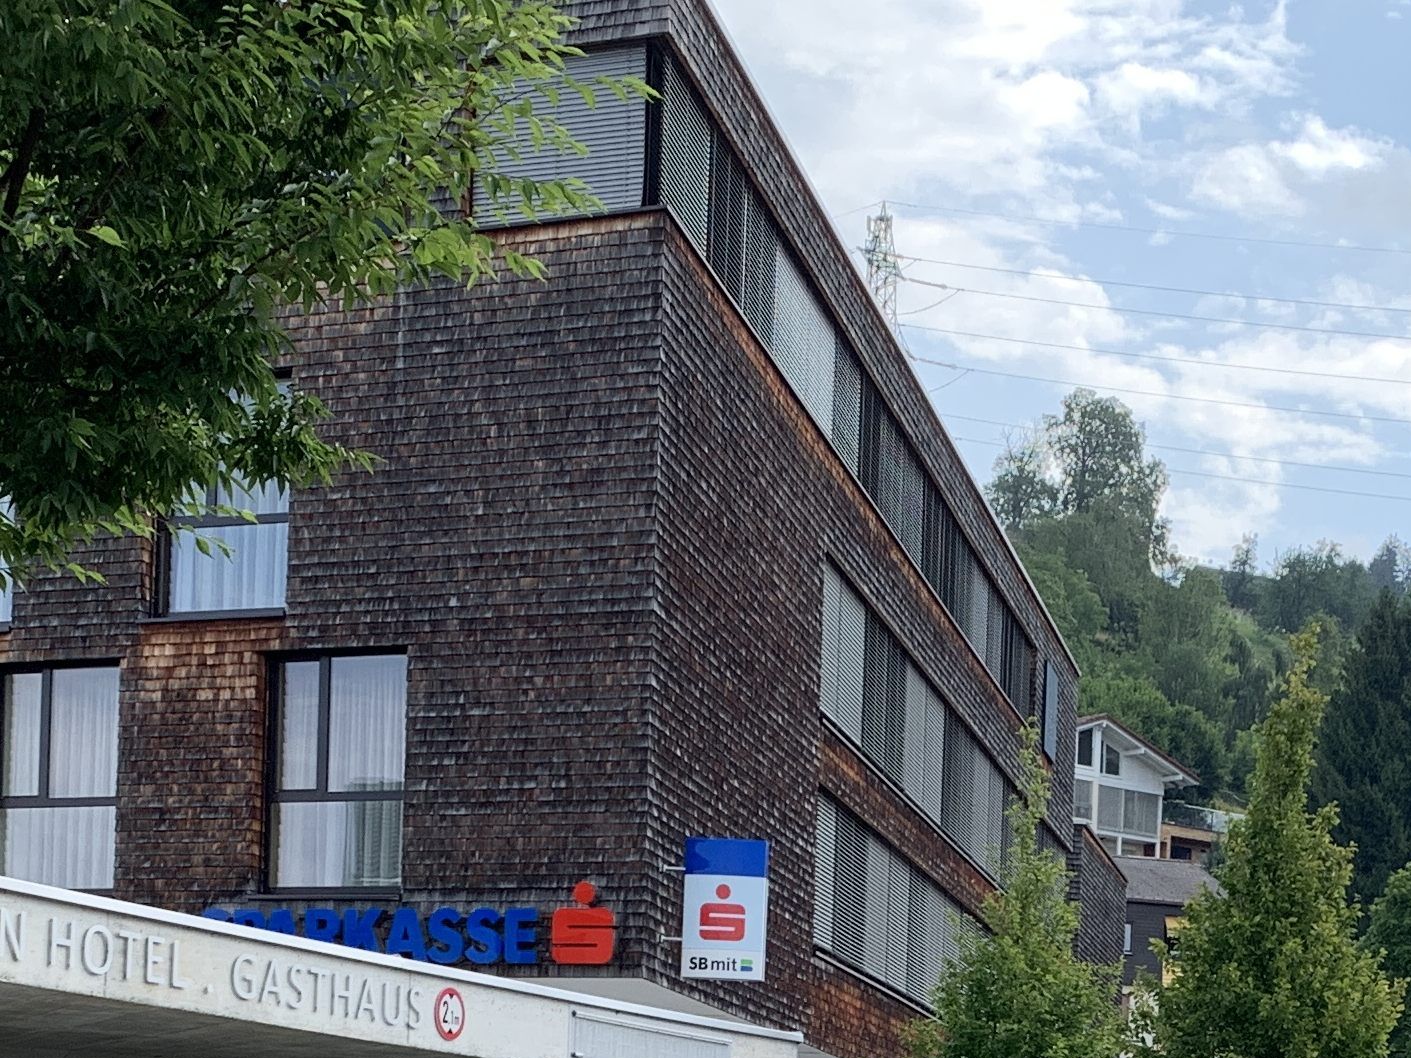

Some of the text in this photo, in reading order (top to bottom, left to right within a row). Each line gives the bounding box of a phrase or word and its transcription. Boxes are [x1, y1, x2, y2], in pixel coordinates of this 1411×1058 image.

[203, 907, 539, 964] RKASSE
[47, 916, 192, 990] HOTEL
[230, 952, 422, 1031] GASTHAUS
[689, 957, 737, 972] SB mit
